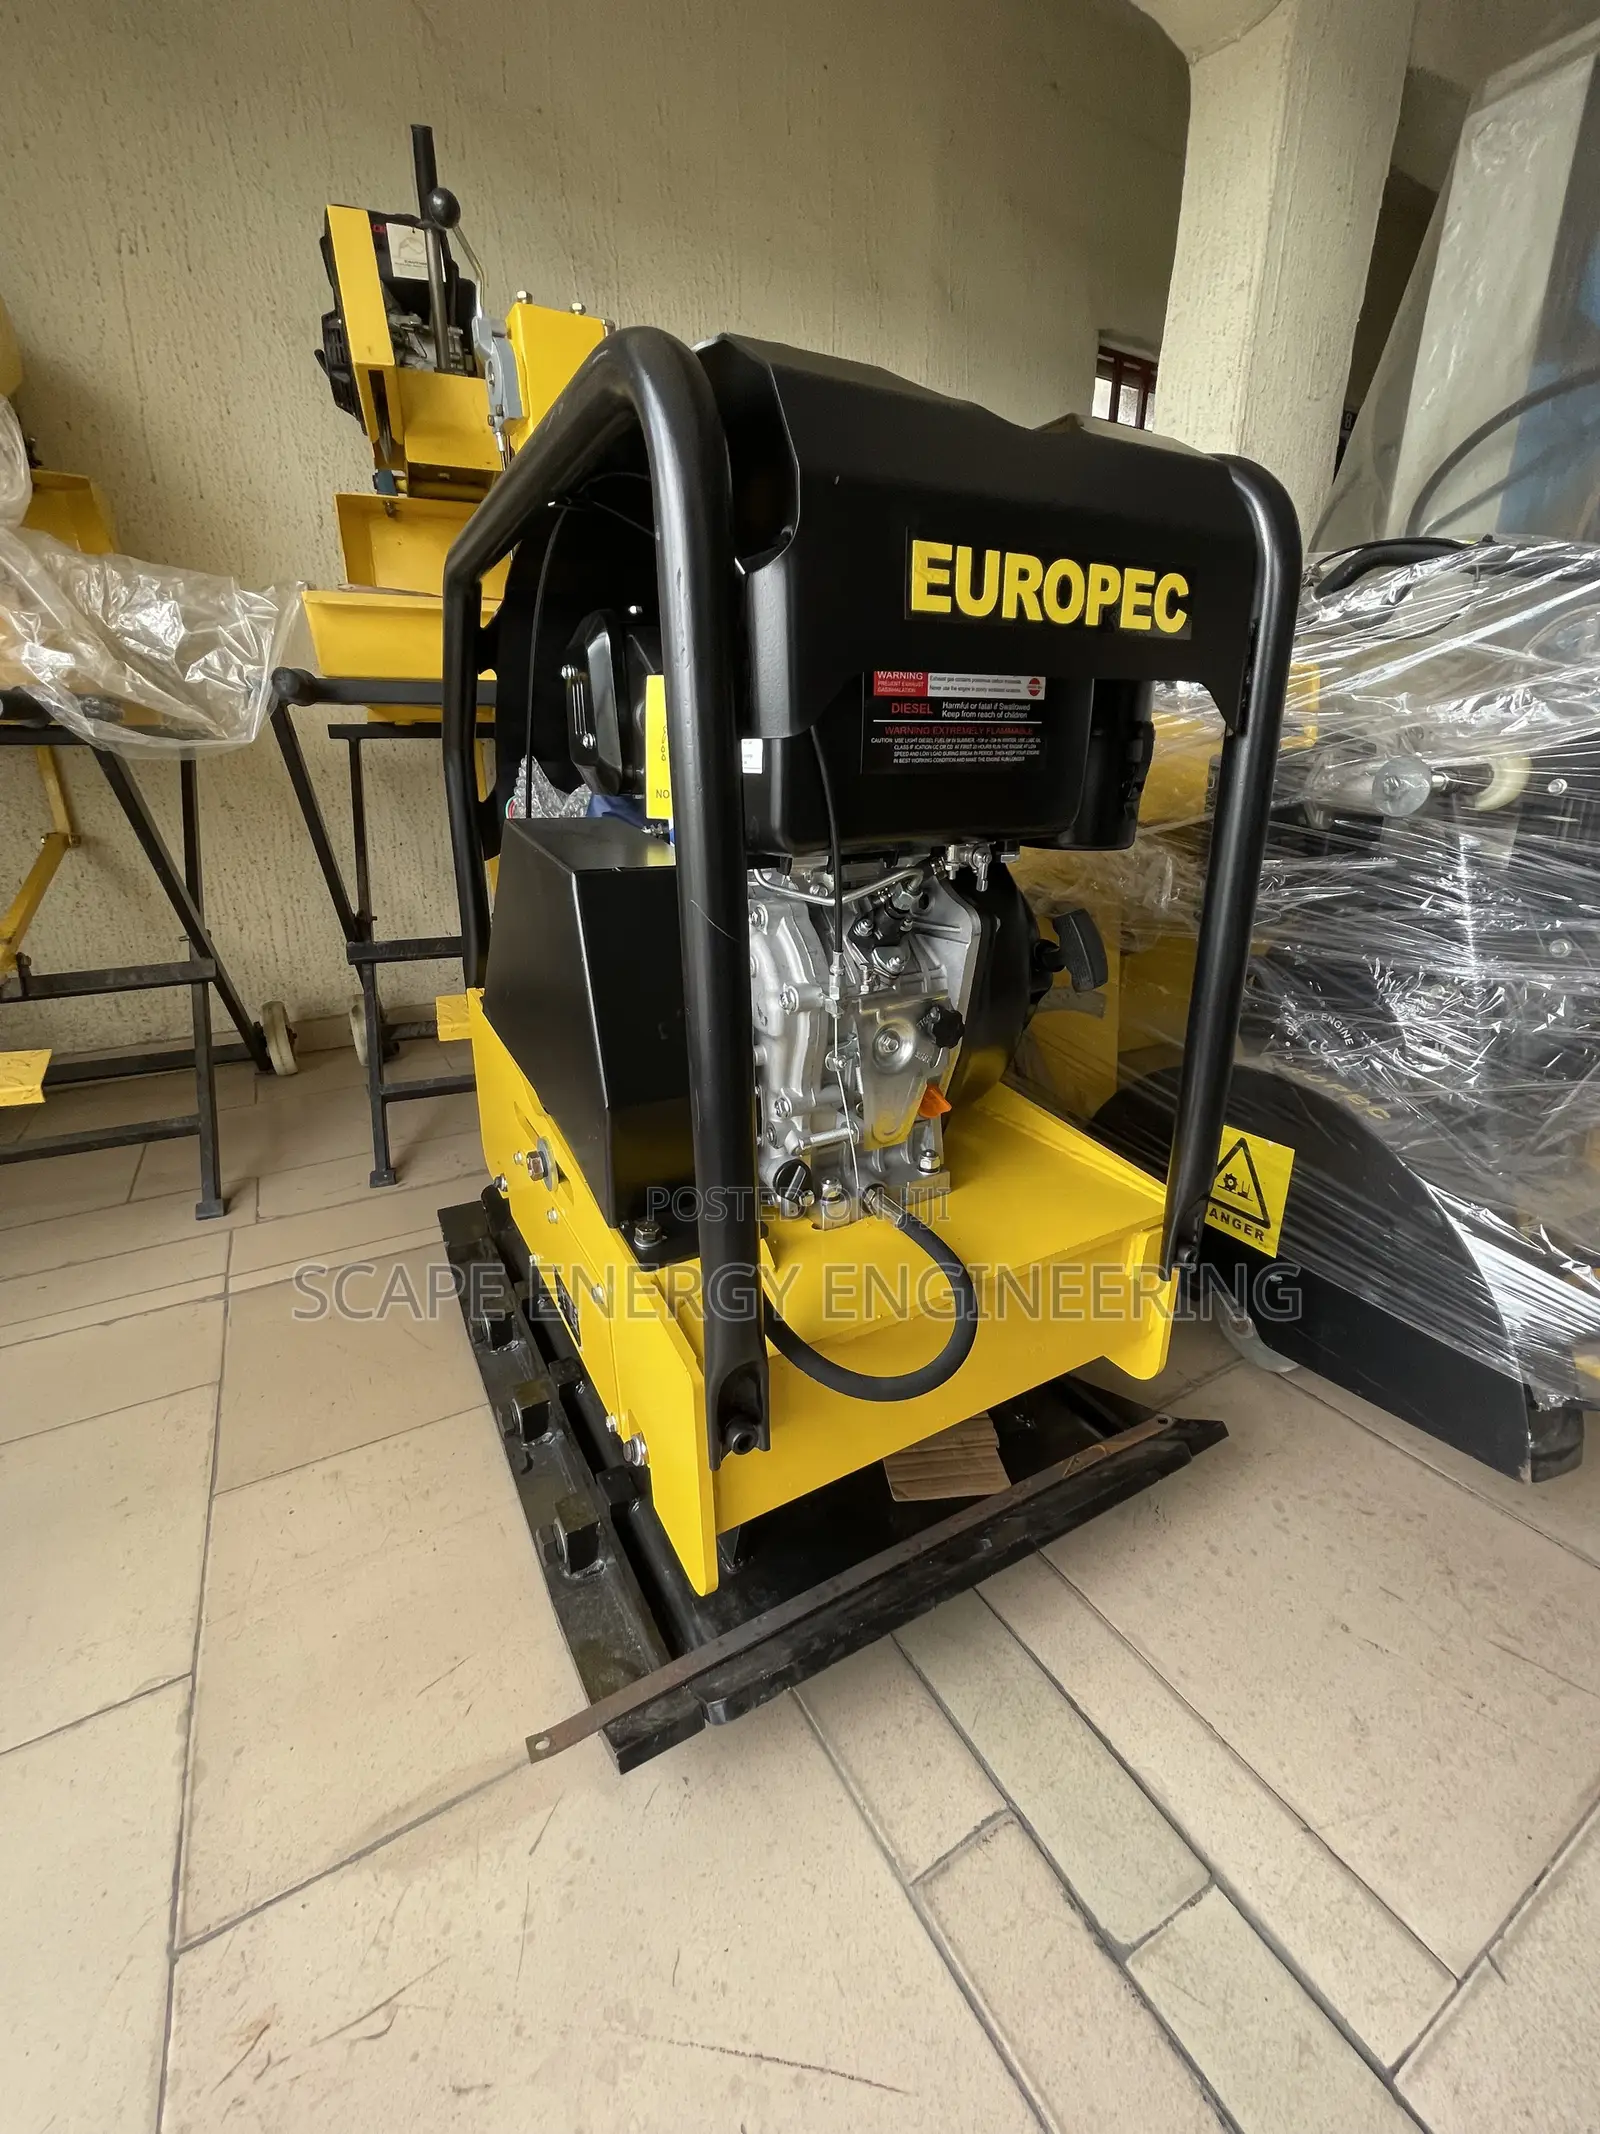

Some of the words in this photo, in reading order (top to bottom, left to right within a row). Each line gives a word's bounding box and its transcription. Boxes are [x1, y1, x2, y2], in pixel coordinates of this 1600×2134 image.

[911, 539, 1189, 633] EUROPEC
[877, 671, 923, 680] WARNING
[891, 702, 933, 715] DIESEL
[942, 701, 969, 710] Harmful
[942, 710, 960, 719] Keep
[961, 710, 977, 719] from
[996, 711, 1003, 719] of
[1004, 711, 1028, 719] children
[884, 726, 930, 736] WARNING
[933, 726, 983, 736] EXTREMELY
[1321, 1012, 1355, 1046] ENGINE
[1208, 1207, 1265, 1242] ANGER
